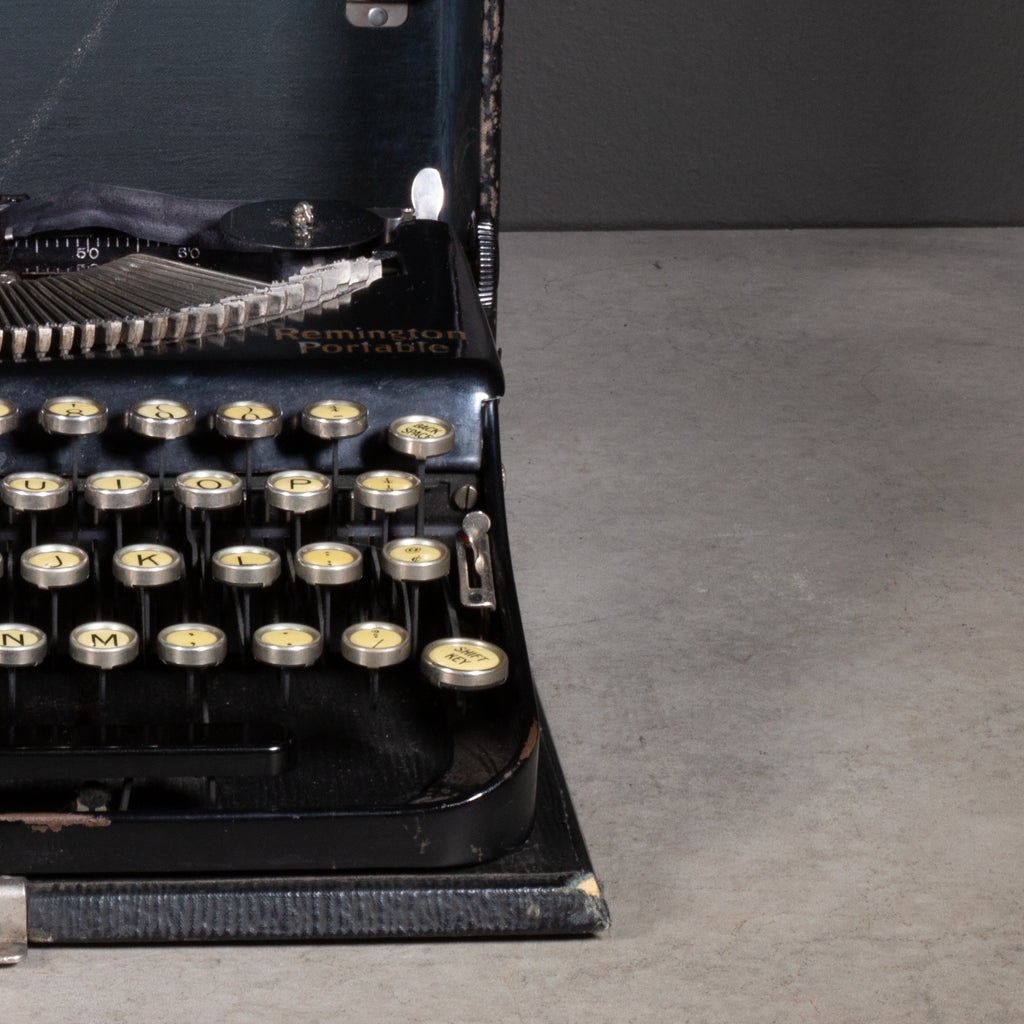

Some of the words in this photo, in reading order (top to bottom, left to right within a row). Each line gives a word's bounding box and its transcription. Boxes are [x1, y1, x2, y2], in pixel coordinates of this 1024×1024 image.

[76, 247, 99, 259] 50
[275, 327, 466, 341] Remington
[299, 341, 449, 354] Portable
[401, 427, 434, 439] SPACE
[413, 423, 442, 434] BACK
[25, 480, 46, 491] U
[197, 479, 221, 490] O
[290, 479, 311, 490] P
[47, 555, 63, 568] J
[137, 554, 159, 566] K
[237, 556, 258, 566] L
[2, 634, 24, 646] N
[91, 634, 118, 647] M
[444, 653, 473, 665] KEY
[453, 646, 489, 663] SHIFT
